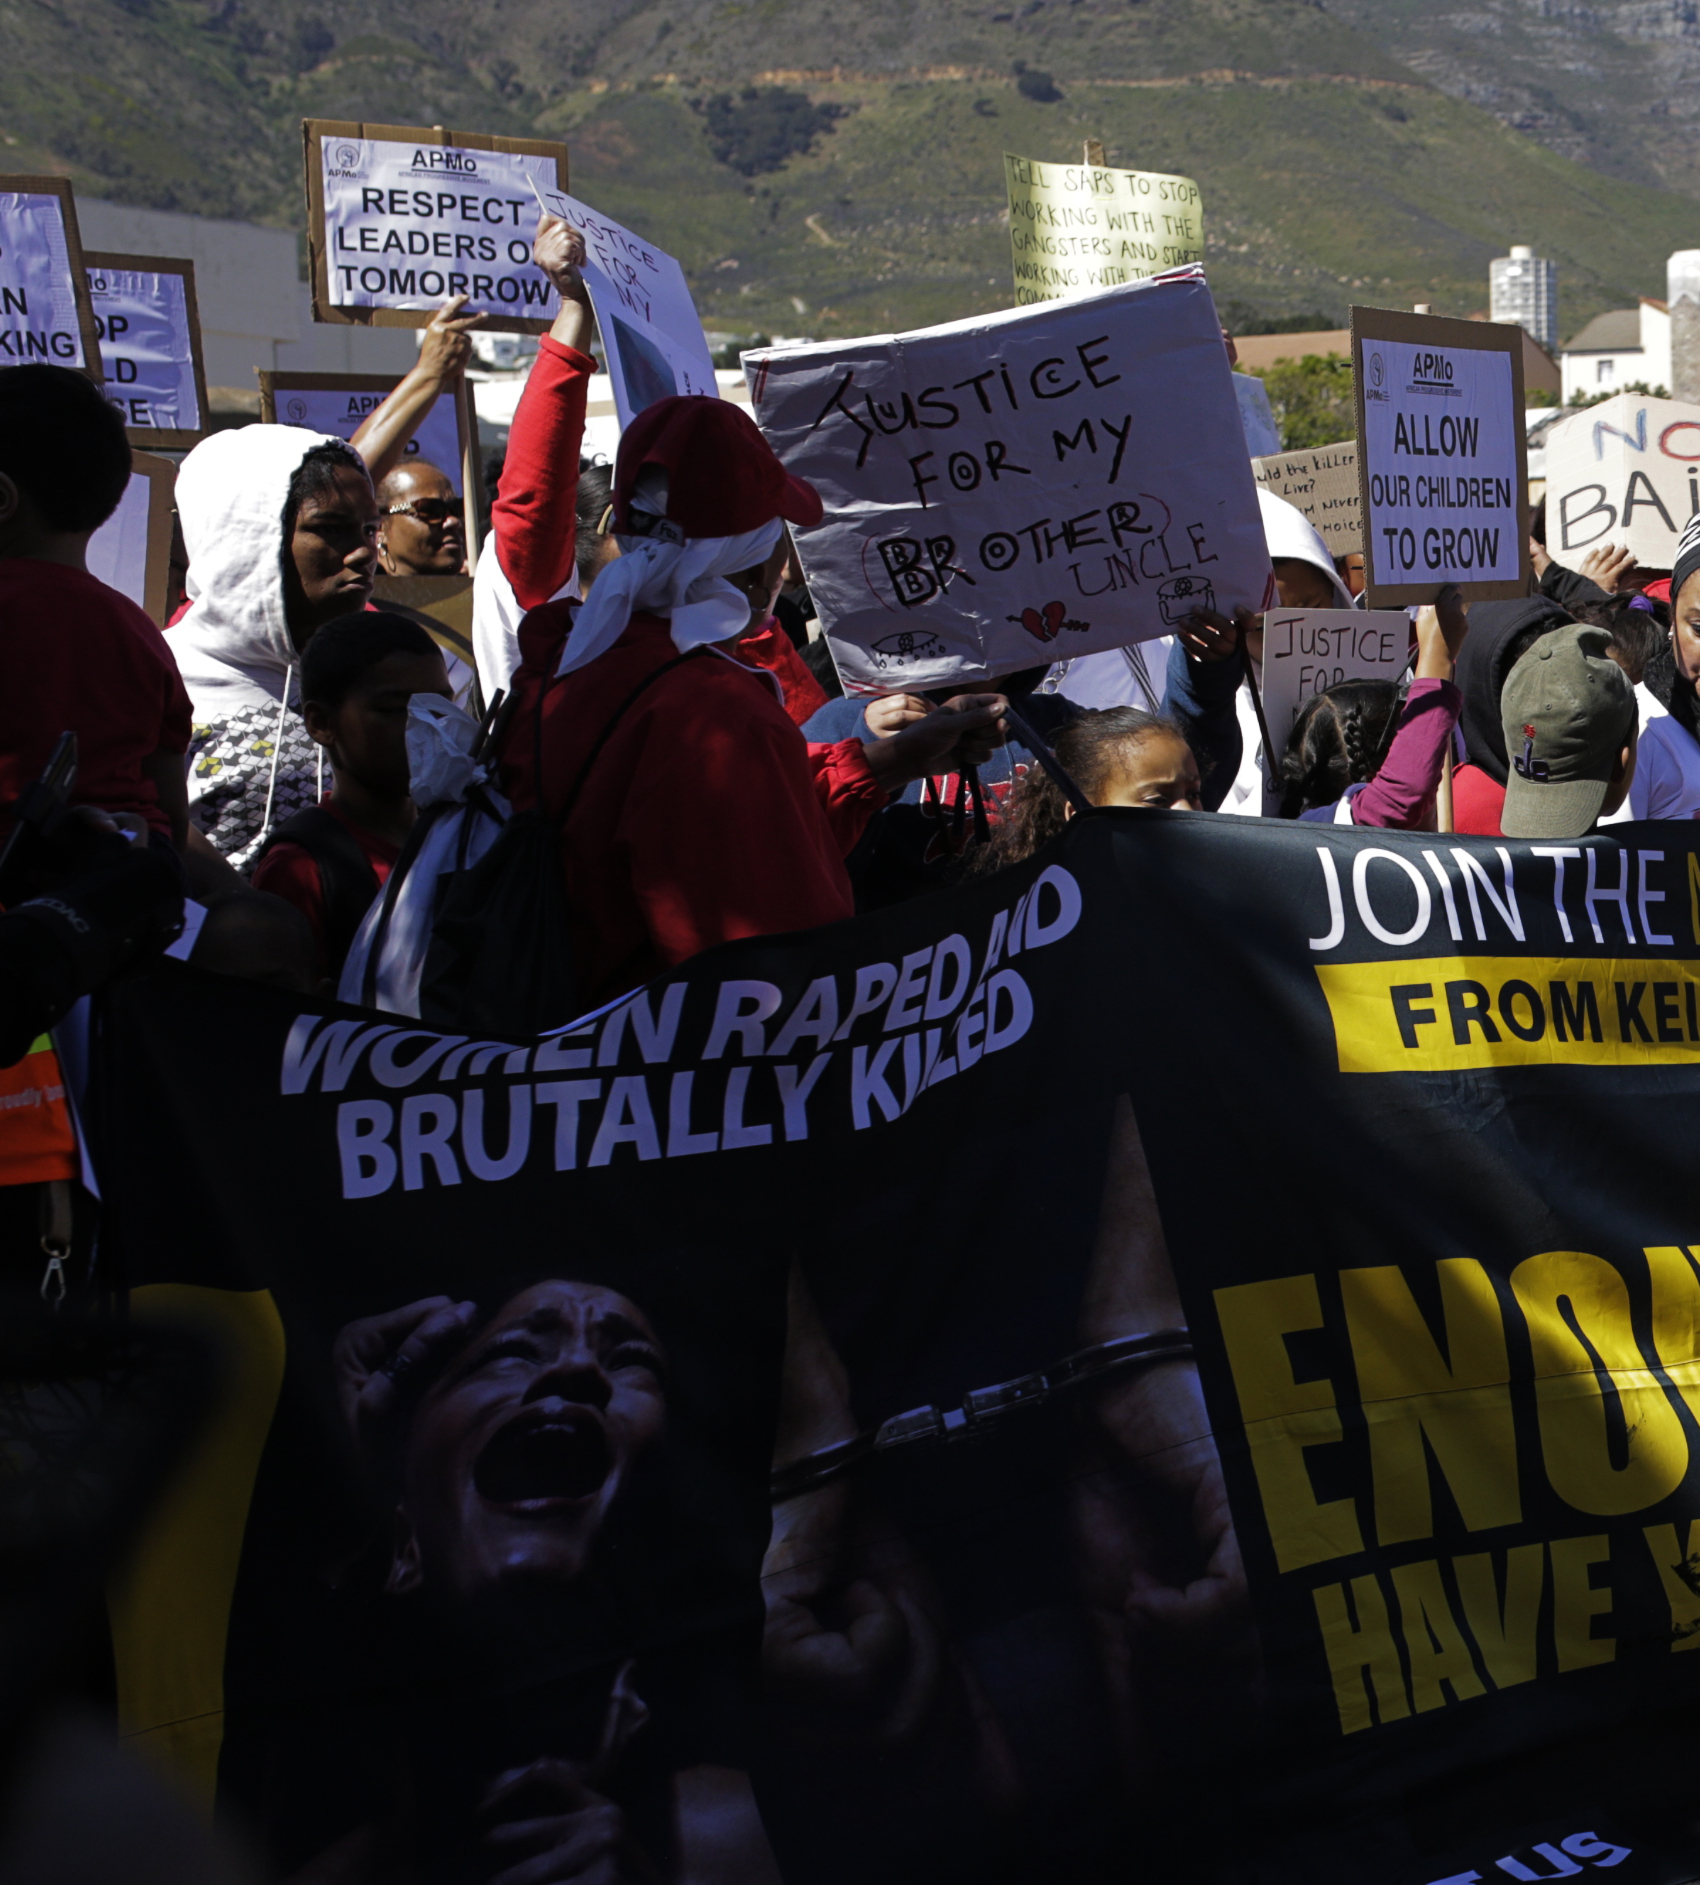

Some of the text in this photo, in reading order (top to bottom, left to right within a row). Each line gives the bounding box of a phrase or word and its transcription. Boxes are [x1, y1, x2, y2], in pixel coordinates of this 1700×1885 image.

[411, 149, 477, 172] APMo
[1006, 155, 1198, 205] TELL SAPS TO STOP
[361, 187, 526, 226] RESPECT
[1011, 195, 1194, 240] WORKING WITH THE
[338, 226, 538, 266] LEADERS O
[1012, 228, 1111, 256] GANGSTERS
[1121, 240, 1157, 261] AND
[337, 265, 551, 306] TOMORROW
[593, 243, 652, 297] FOR
[1015, 258, 1078, 286] WORKING
[1087, 267, 1125, 286] WITH
[612, 279, 651, 322] MY
[1413, 352, 1453, 380] APMo
[347, 397, 388, 413] APM
[1394, 412, 1479, 457] ALLOW
[908, 415, 1132, 508] FOR MY
[1257, 467, 1281, 482] uld
[1371, 474, 1511, 508] OUR CHILDREN
[1068, 522, 1220, 597] UNCLE
[1383, 527, 1499, 570] TO GROW
[1273, 617, 1395, 662] JUSTICE
[1308, 846, 1526, 951] JOIN
[1530, 846, 1674, 946] THE
[701, 932, 971, 1061] RAPED
[1390, 978, 1610, 1049] FROM
[336, 1053, 832, 1200] BRUTALLY
[1311, 1534, 1617, 1736] HAVE
